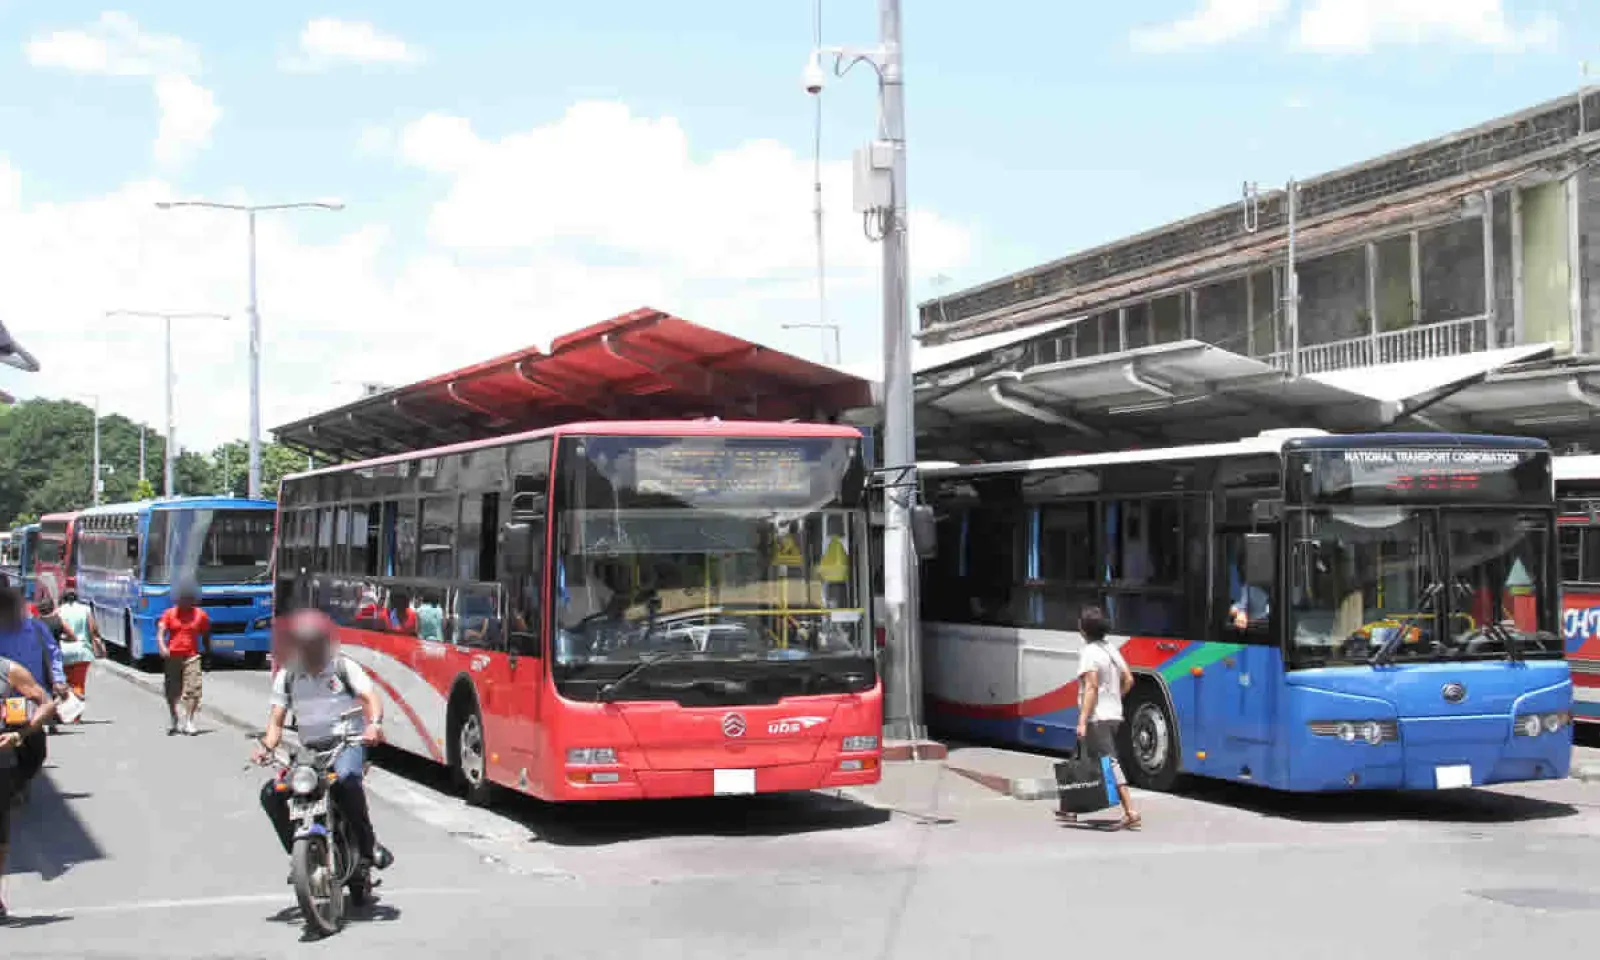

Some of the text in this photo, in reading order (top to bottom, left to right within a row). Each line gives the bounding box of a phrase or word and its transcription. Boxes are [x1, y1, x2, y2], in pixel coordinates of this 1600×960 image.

[1344, 450, 1519, 463] NATIONAL TRANSPORT CORPORATION
